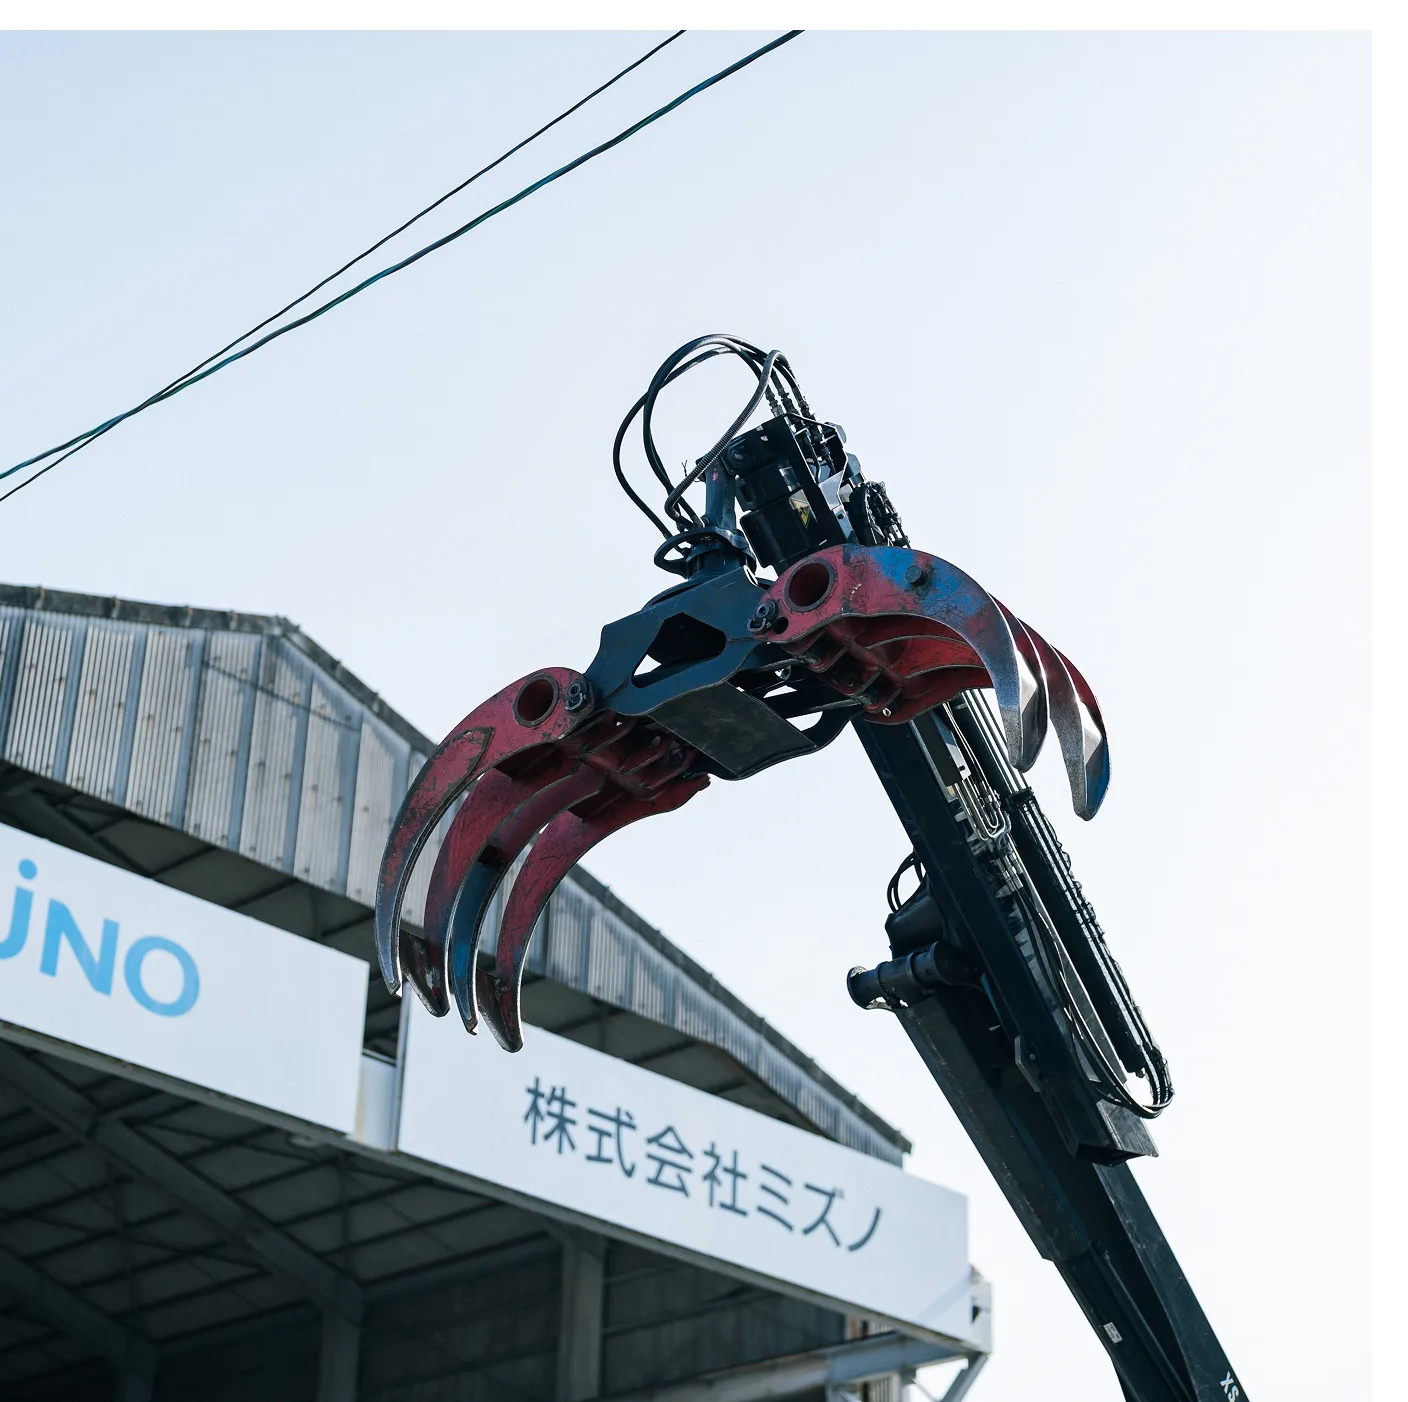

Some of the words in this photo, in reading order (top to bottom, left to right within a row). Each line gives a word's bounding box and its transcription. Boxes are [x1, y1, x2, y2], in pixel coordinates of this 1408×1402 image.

[524, 1076, 882, 1252] 株式会社ミズノ
